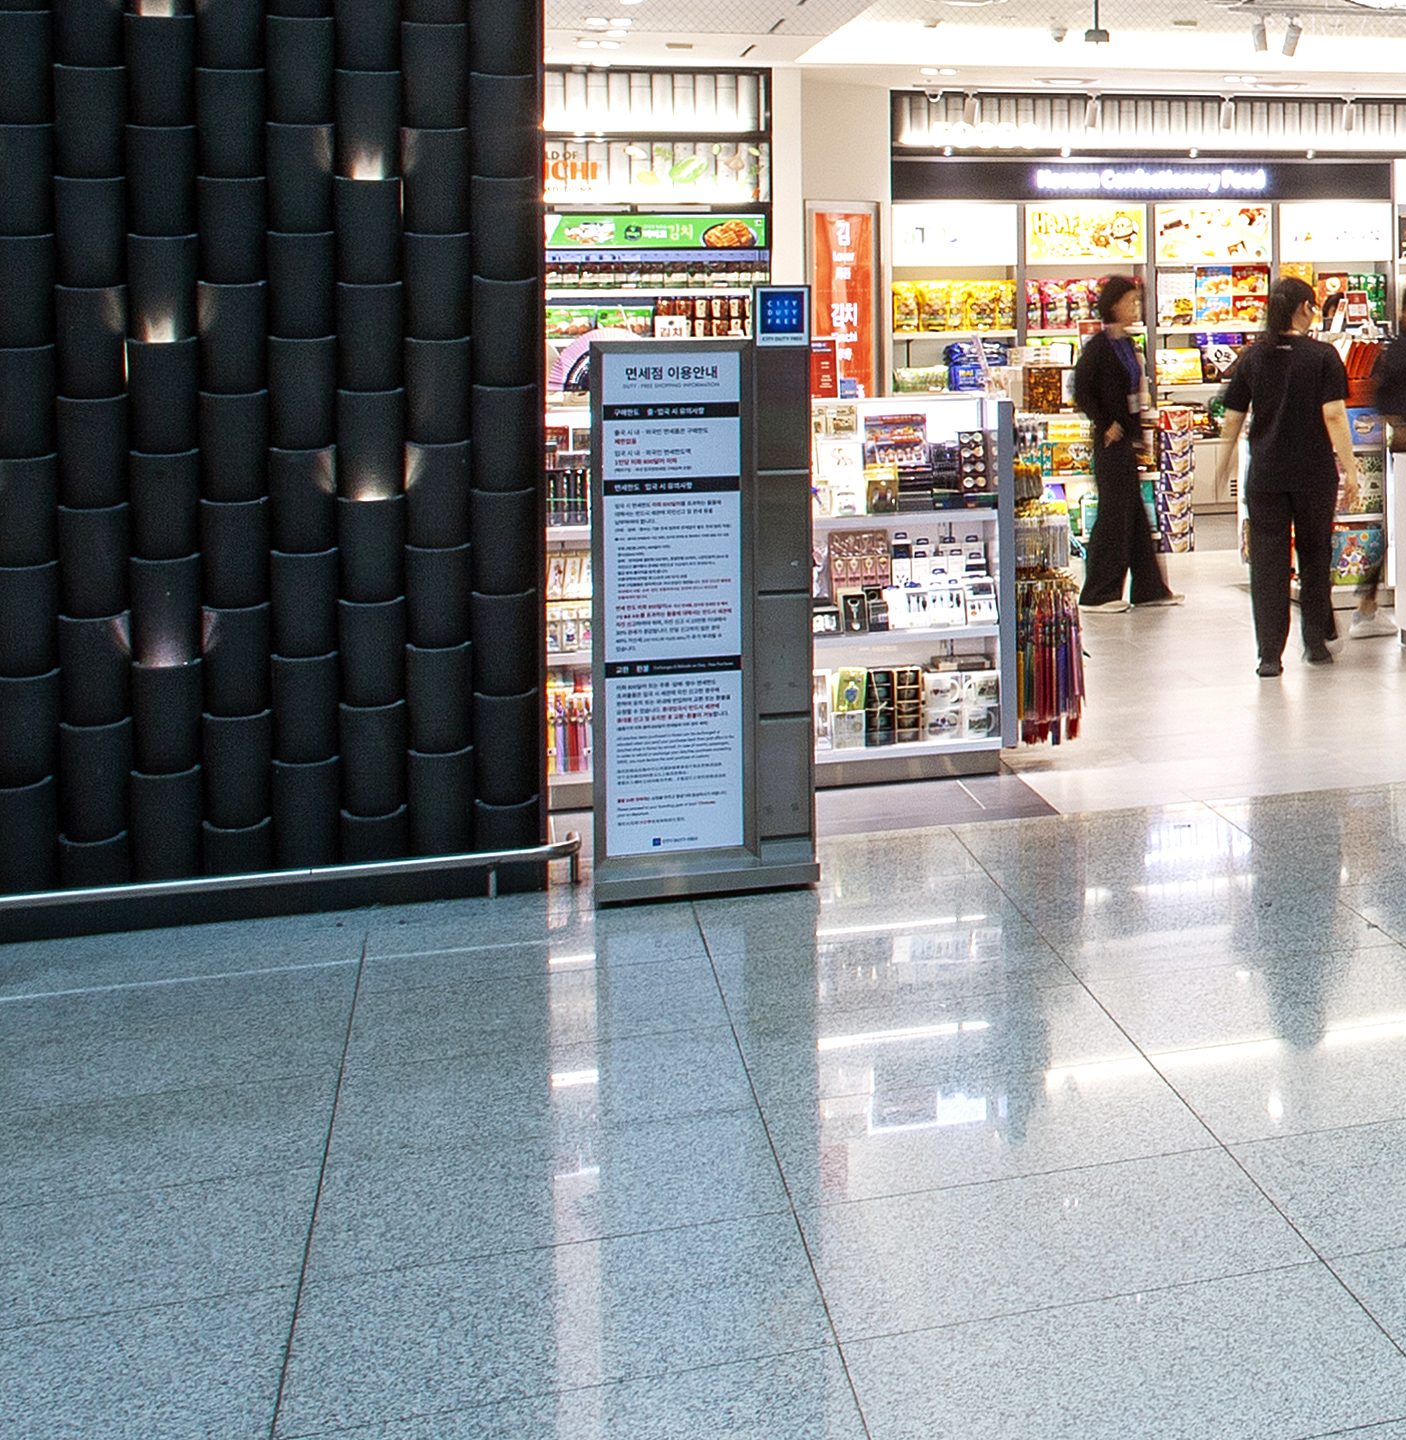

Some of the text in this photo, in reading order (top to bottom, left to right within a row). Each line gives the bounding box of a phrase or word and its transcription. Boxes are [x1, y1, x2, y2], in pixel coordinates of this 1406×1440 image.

[767, 299, 798, 308] CITY
[767, 309, 798, 317] DUTY
[831, 302, 858, 327] 김치
[767, 317, 798, 326] FREE
[625, 365, 719, 381] 면세점 이용안내
